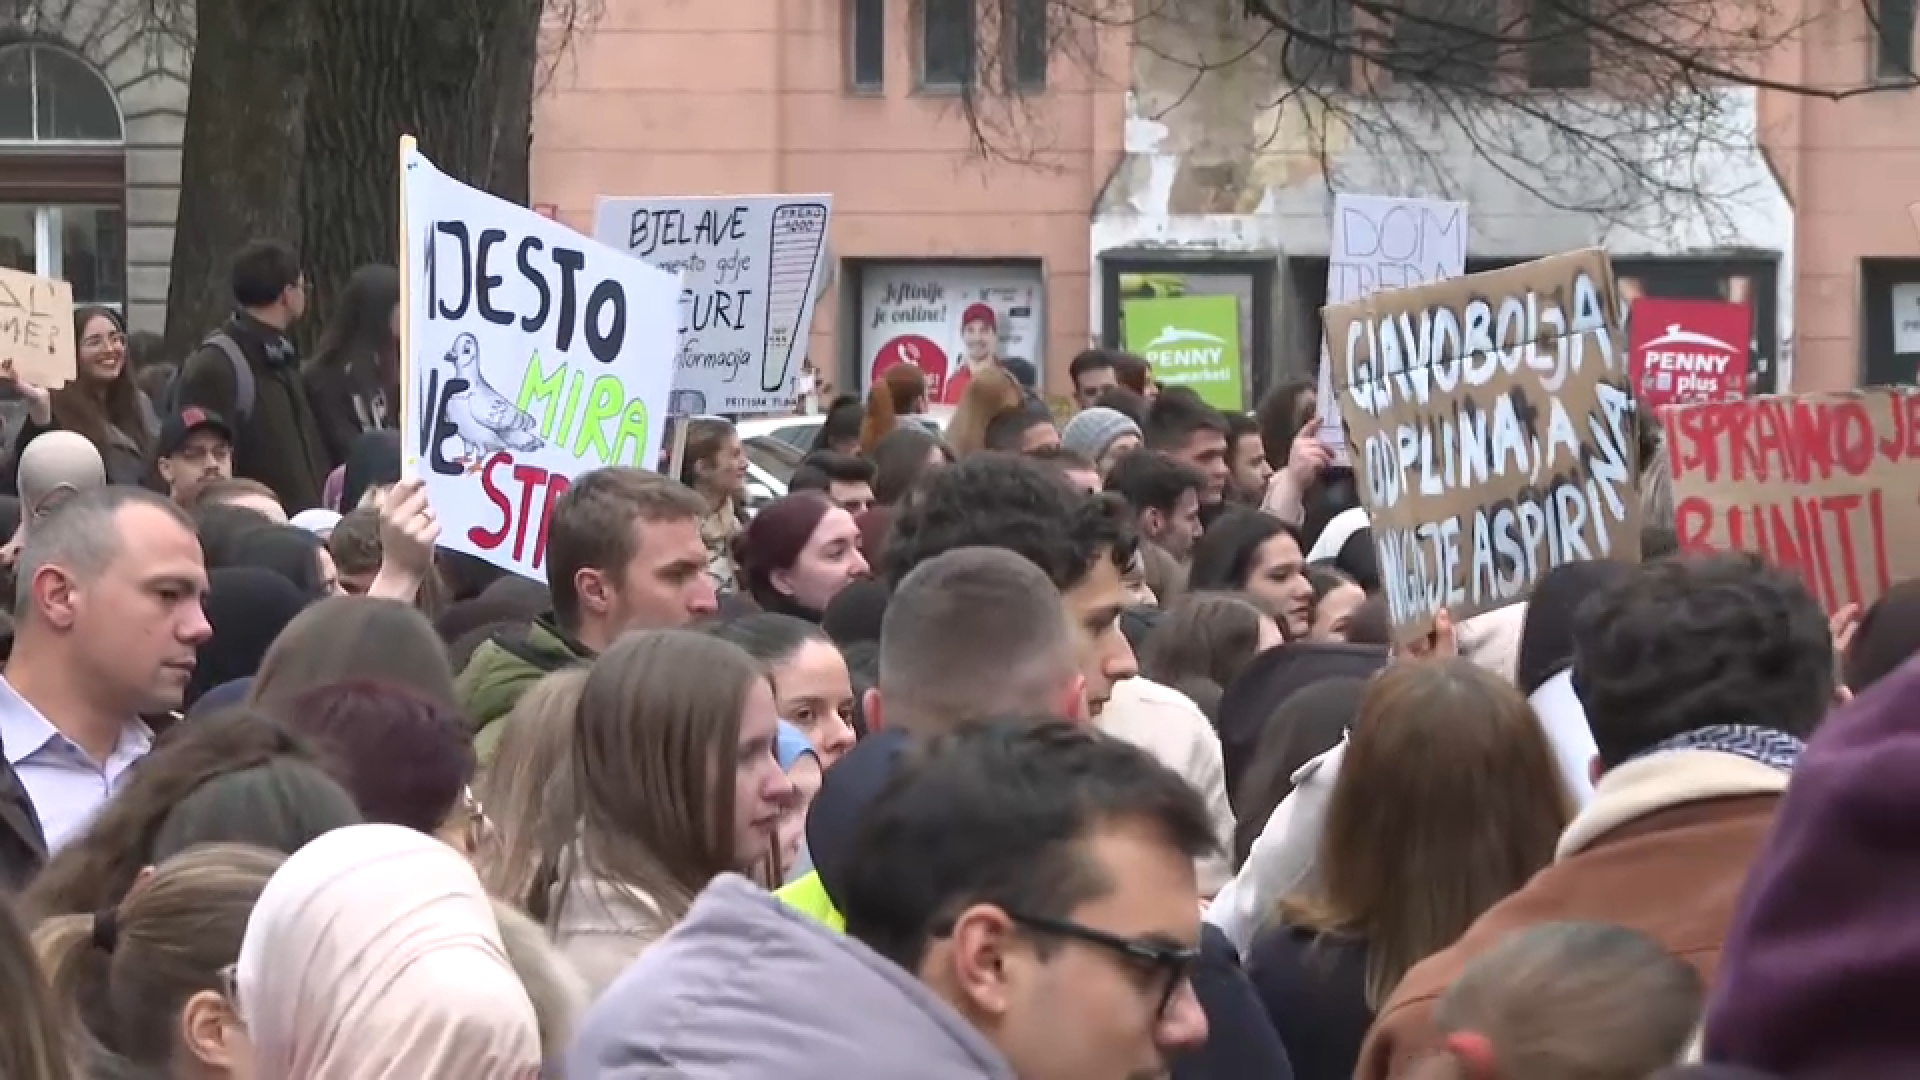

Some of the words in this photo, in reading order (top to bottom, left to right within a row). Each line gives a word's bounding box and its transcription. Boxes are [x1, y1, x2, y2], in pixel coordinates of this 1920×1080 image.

[629, 206, 749, 256] BJELAVE
[1343, 205, 1462, 263] DOM
[872, 305, 886, 329] je
[891, 303, 947, 323] online!
[1145, 347, 1222, 368] PENNY
[1645, 351, 1730, 374] PENNY
[1677, 372, 1718, 396] plus
[516, 349, 648, 468] MIRA
